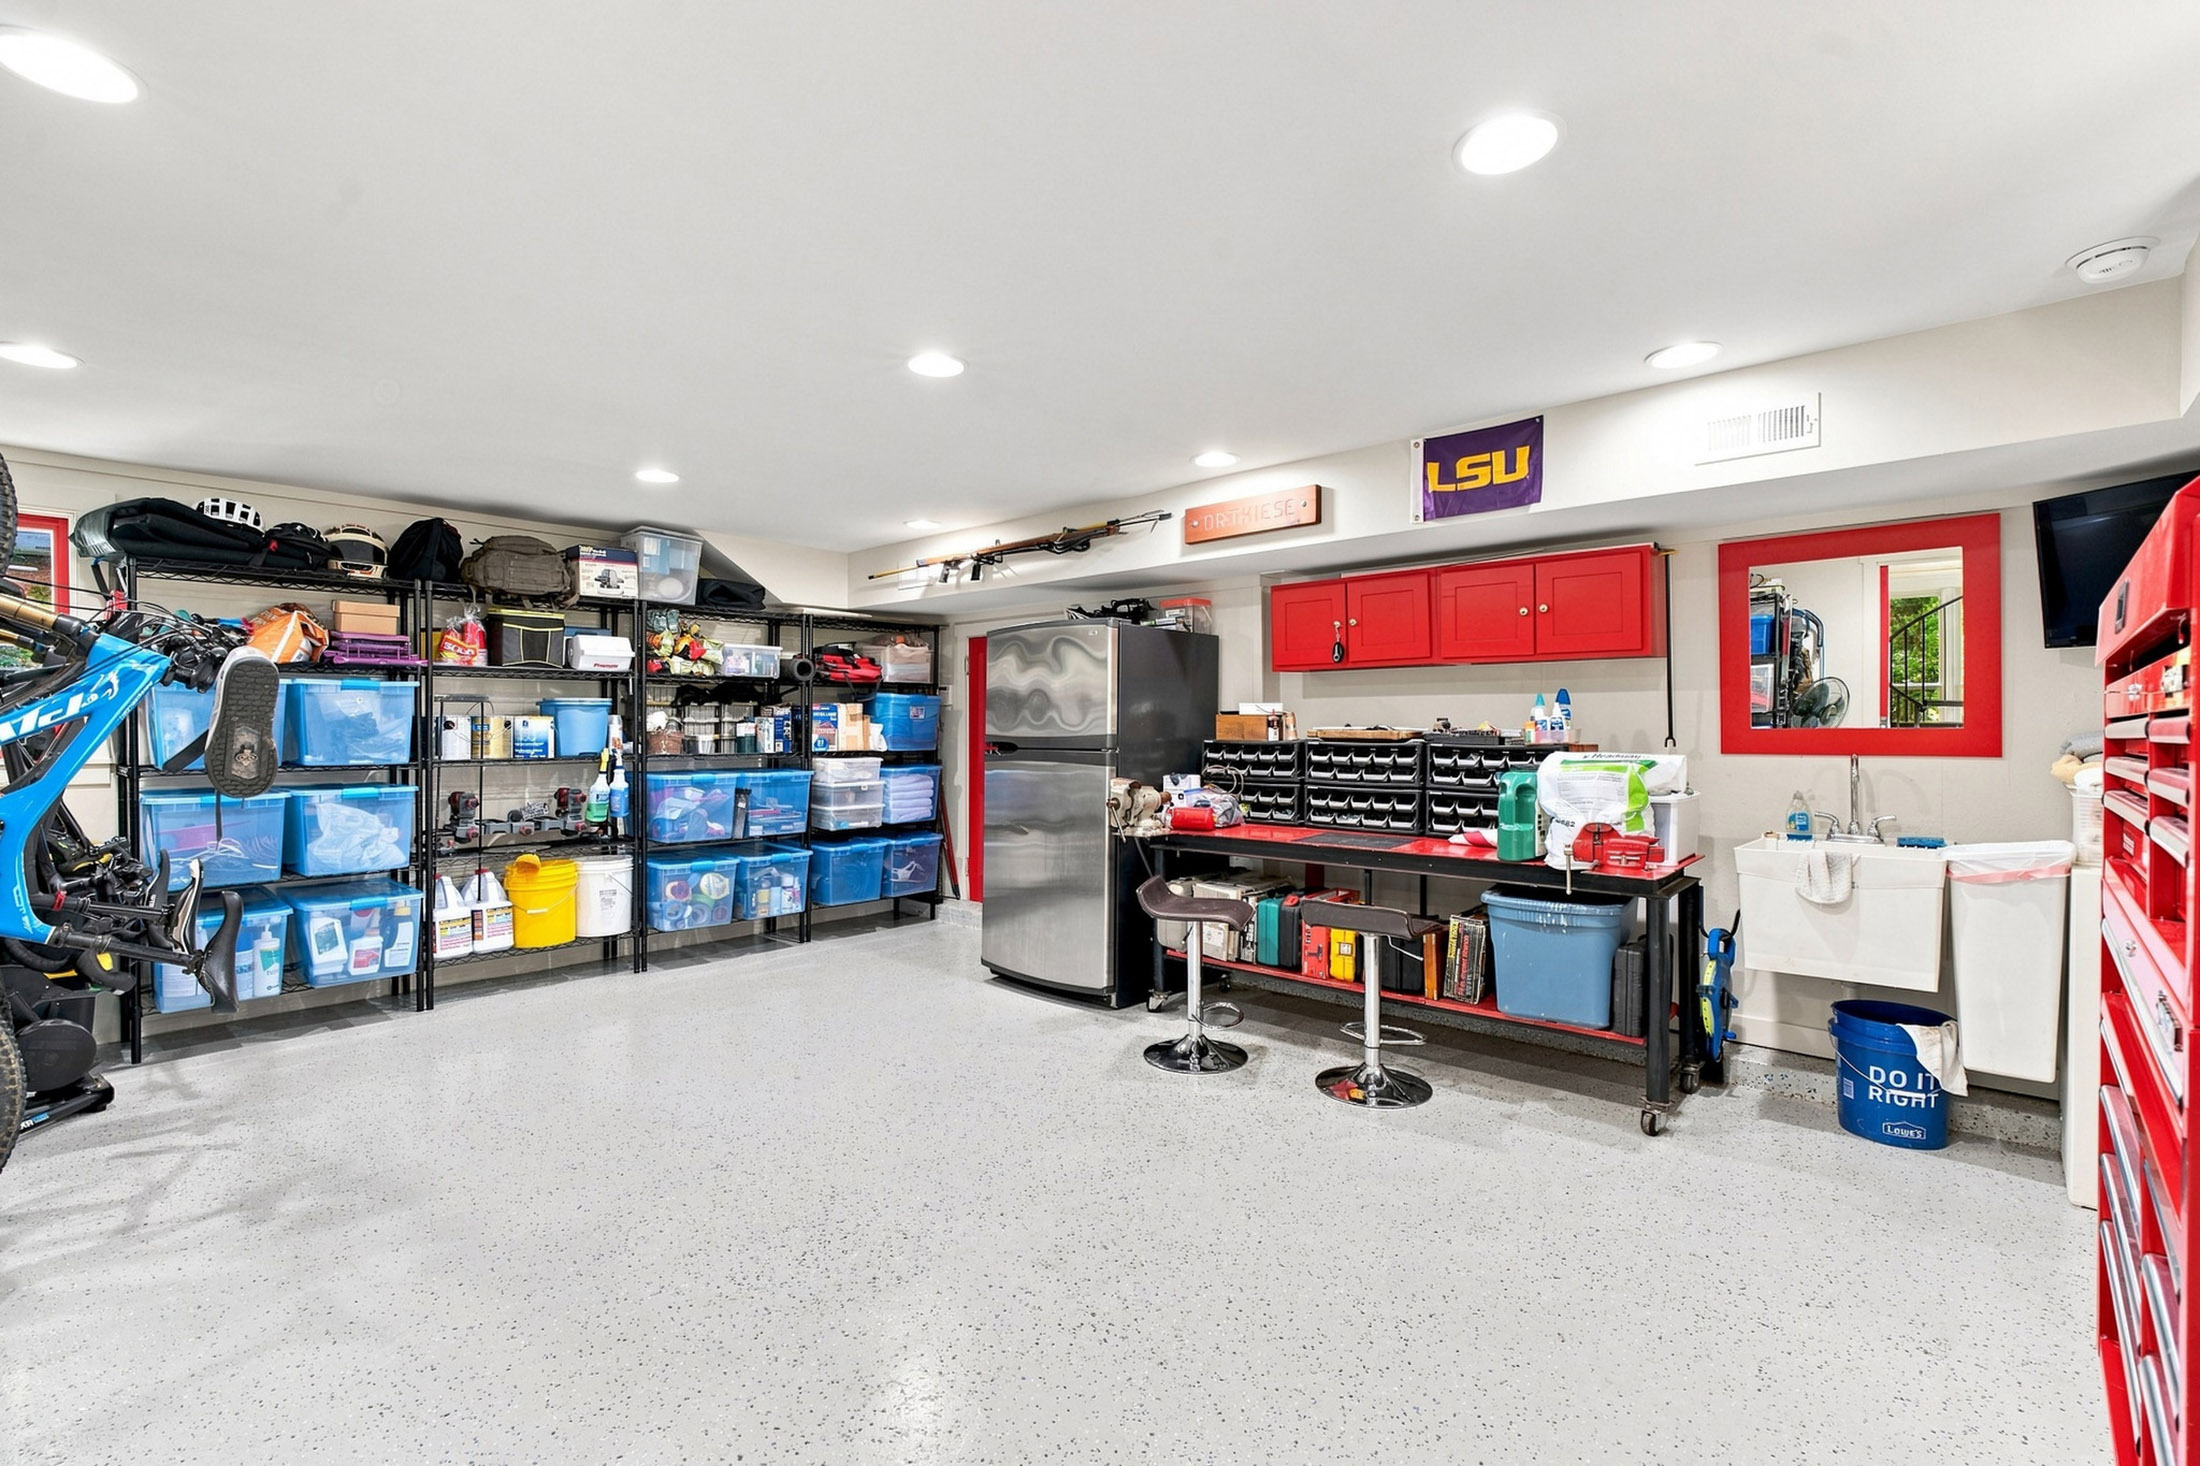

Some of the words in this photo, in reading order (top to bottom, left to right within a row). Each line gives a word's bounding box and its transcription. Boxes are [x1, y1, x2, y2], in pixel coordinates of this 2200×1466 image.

[1426, 444, 1531, 493] LSU
[1869, 1065, 1908, 1088] DO
[1917, 1072, 1936, 1090] IT
[1868, 1085, 1939, 1109] RIGHT
